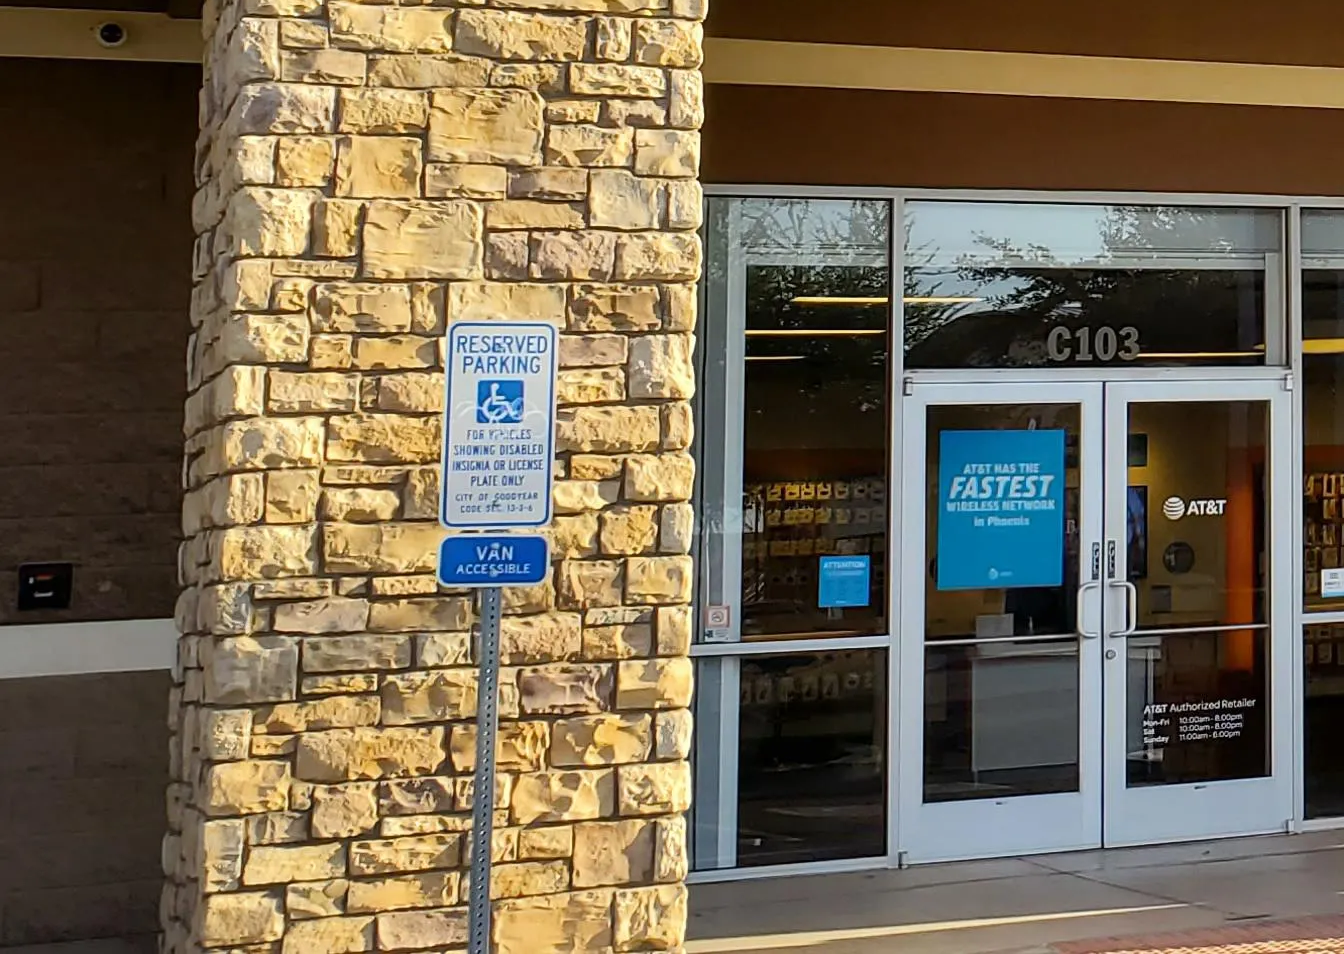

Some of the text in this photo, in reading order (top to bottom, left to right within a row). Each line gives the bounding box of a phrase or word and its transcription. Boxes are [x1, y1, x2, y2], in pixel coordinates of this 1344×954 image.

[456, 335, 548, 354] RESERVED
[1047, 326, 1140, 361] C103
[462, 355, 541, 374] PARKING
[467, 429, 532, 440] FOR VECLES
[453, 444, 544, 456] SHOWING DISABLED
[452, 459, 544, 471] INSIGNIA OR LICENSE
[963, 462, 1041, 475] AT&T HAS THE
[470, 475, 525, 486] PLATE ONLY
[949, 475, 1055, 500] FASTEST
[455, 493, 473, 501] CITY
[946, 499, 1055, 512] WIRELESS NETWORK
[1187, 499, 1227, 515] AT&T
[476, 545, 514, 561] VAN
[456, 563, 531, 575] ACCESSIBLE
[1143, 698, 1256, 714] AT&T Authorized Retailer
